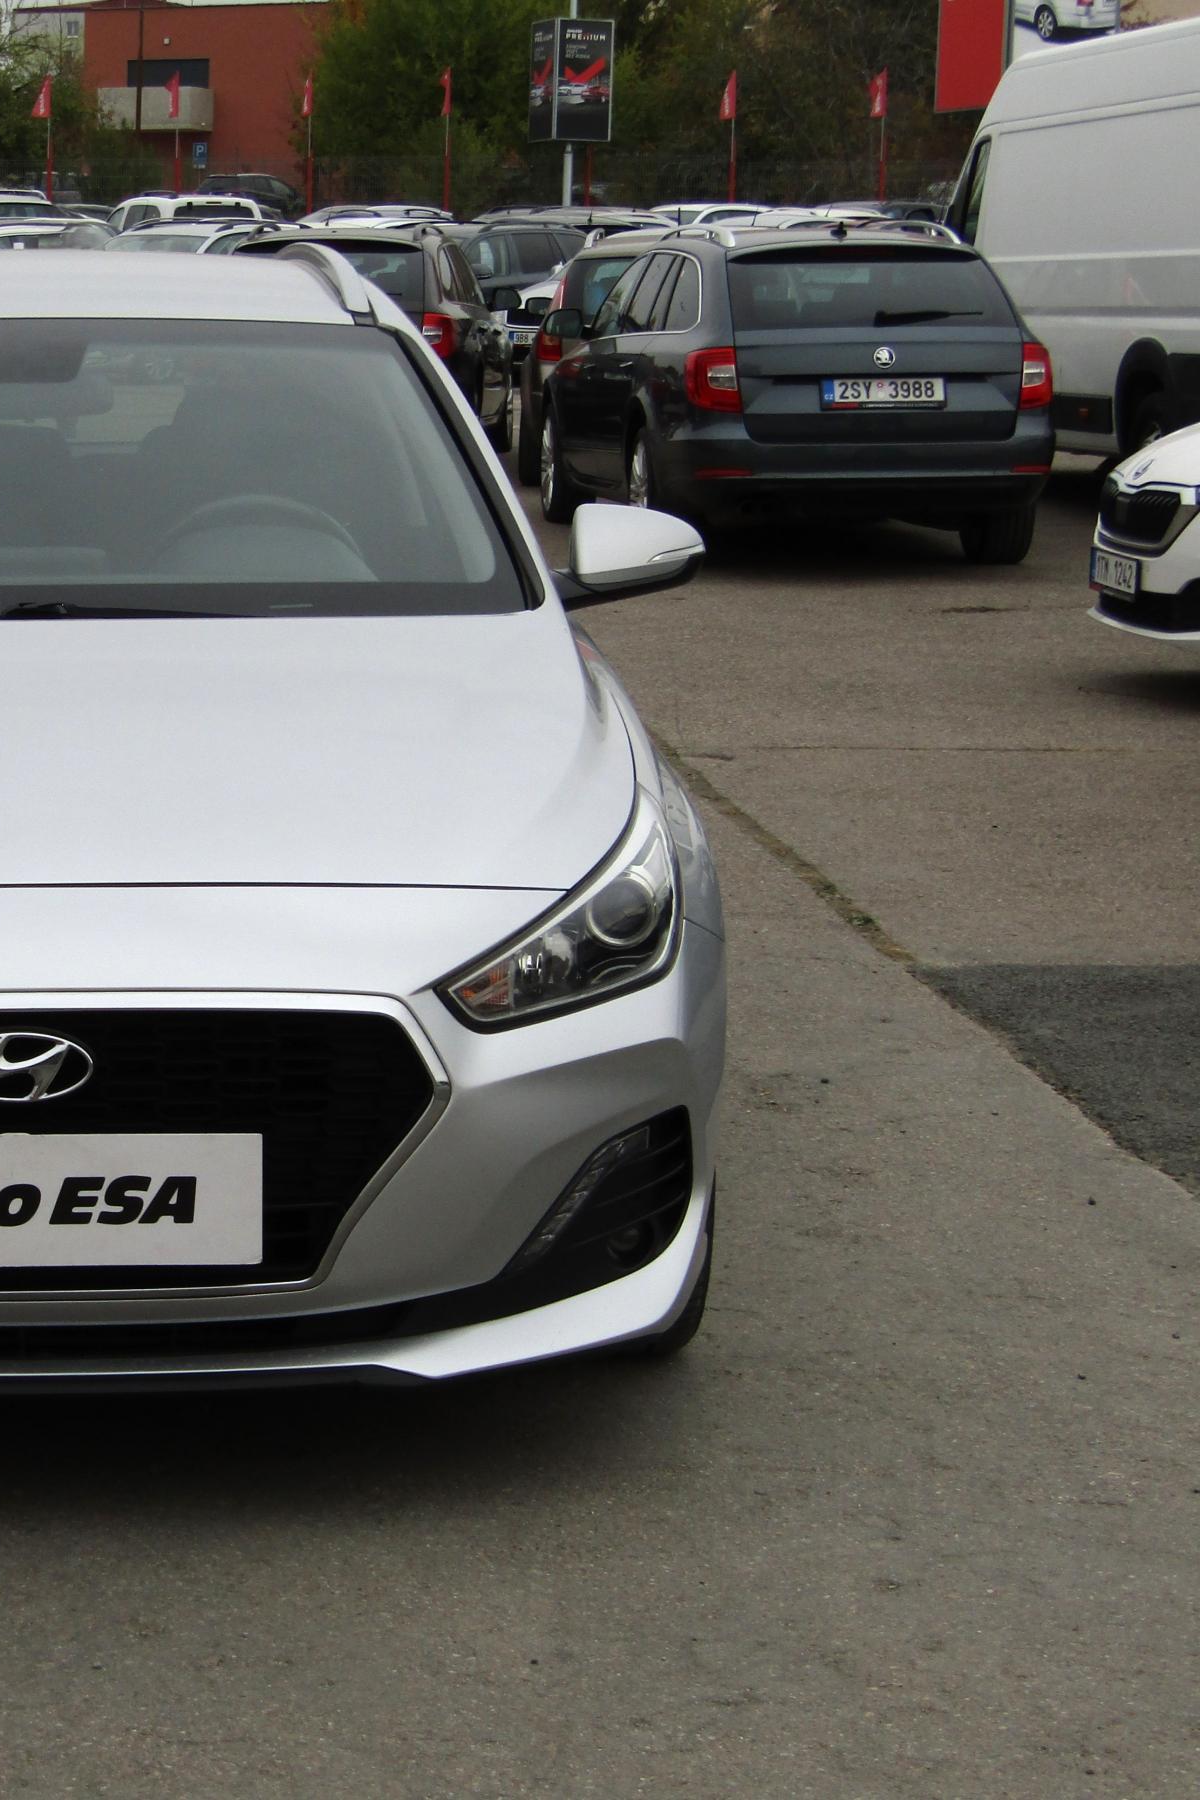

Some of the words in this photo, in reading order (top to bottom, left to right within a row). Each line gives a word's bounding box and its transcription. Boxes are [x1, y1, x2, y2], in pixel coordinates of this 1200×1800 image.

[196, 145, 204, 157] P
[838, 381, 872, 400] 2SY
[888, 381, 935, 399] 3988
[1114, 559, 1133, 589] 1242
[48, 1175, 197, 1226] ESA
